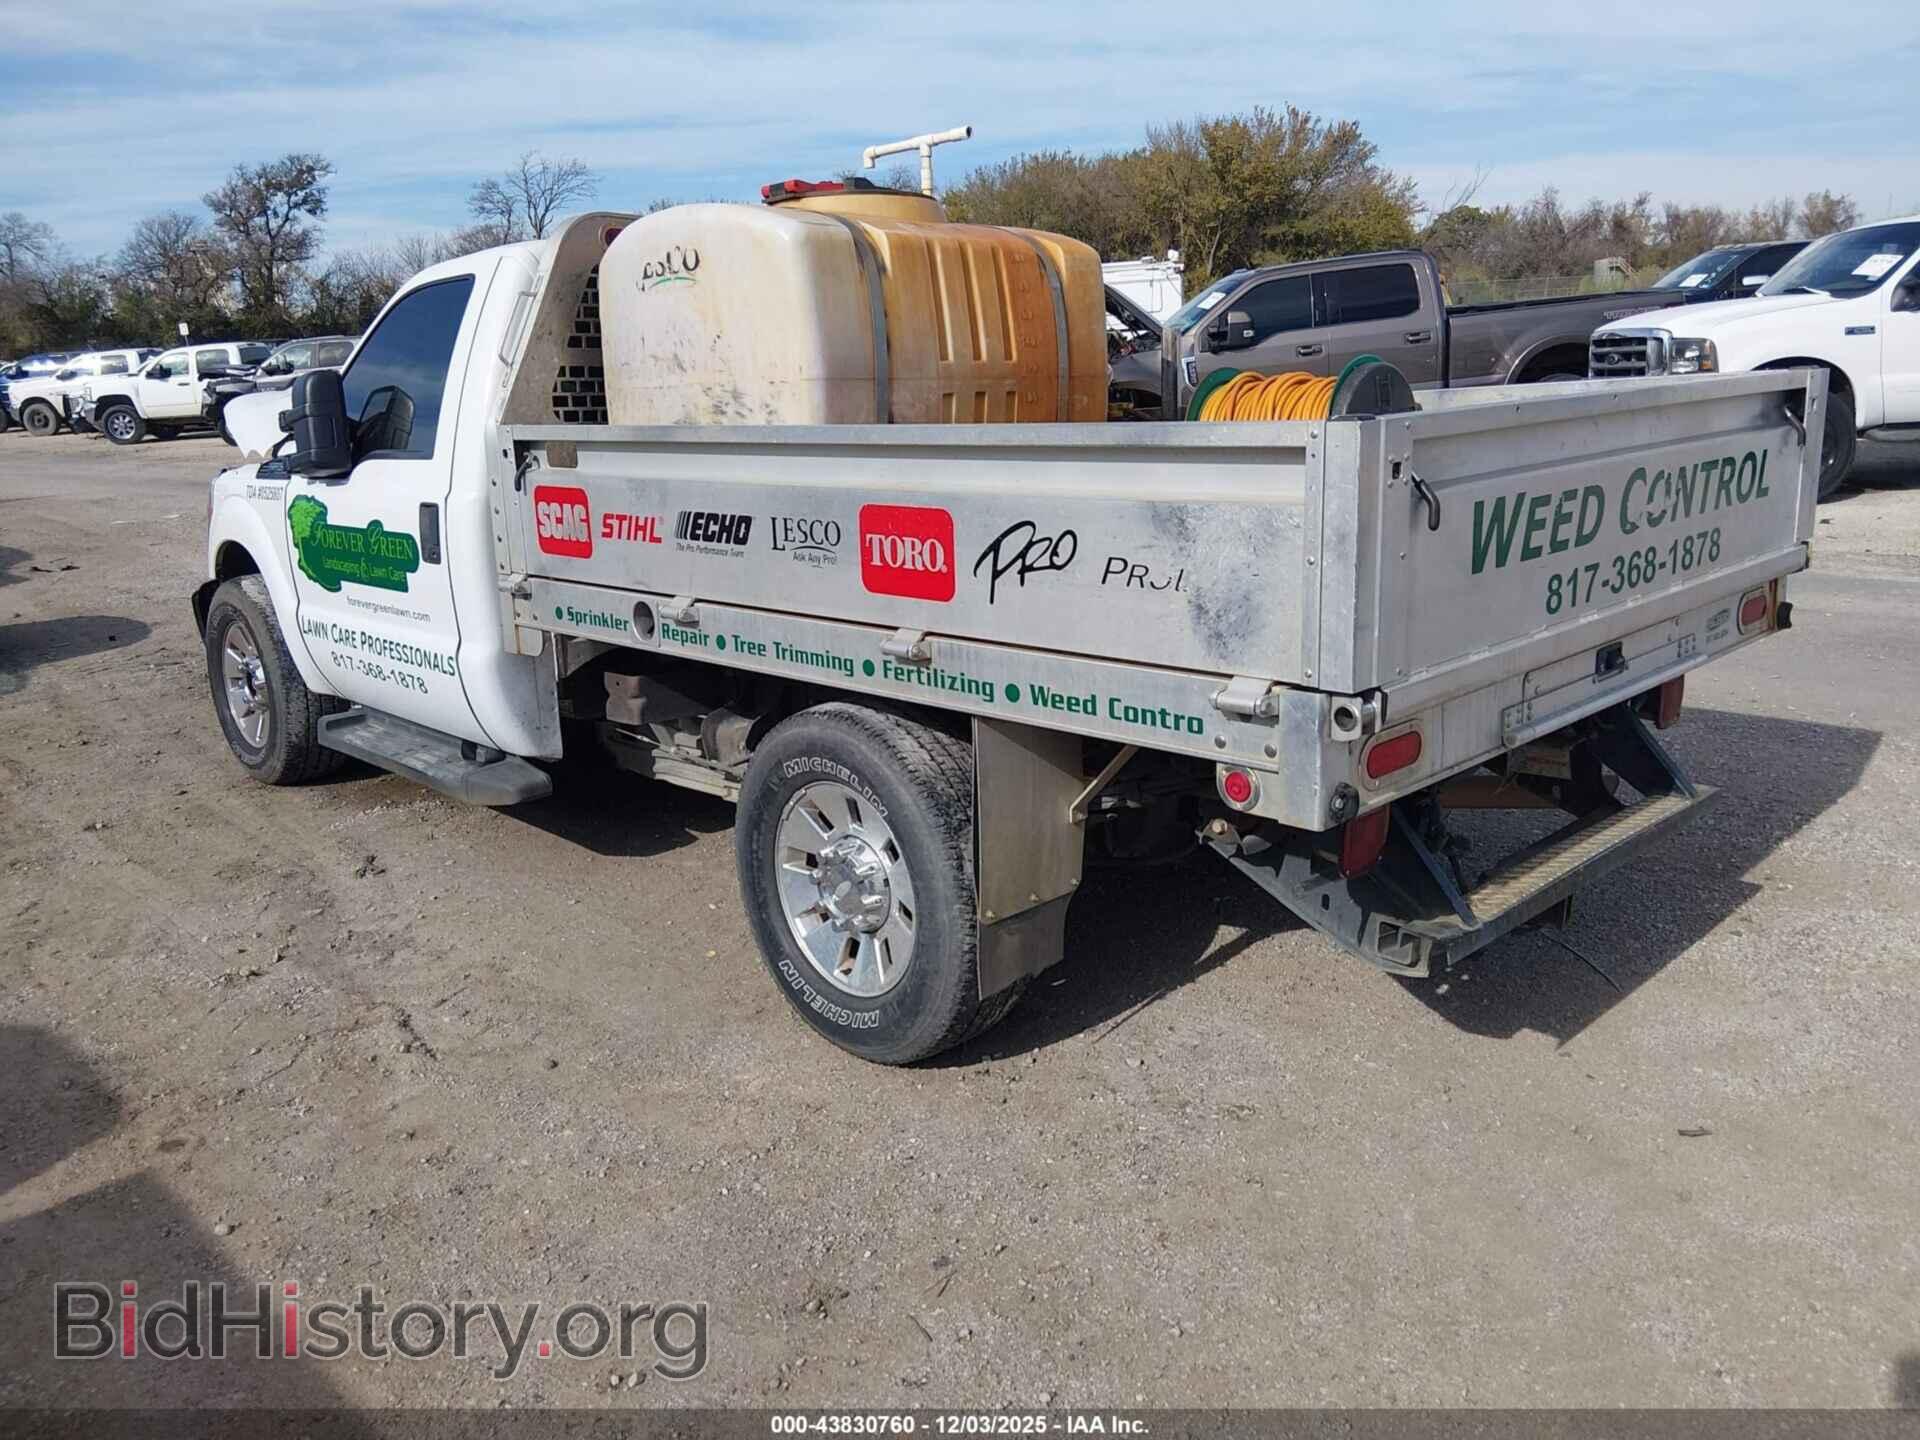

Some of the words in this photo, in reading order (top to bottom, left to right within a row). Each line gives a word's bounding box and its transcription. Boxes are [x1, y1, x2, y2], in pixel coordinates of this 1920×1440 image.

[536, 501, 590, 543] SCAG
[601, 512, 663, 544] STIHL
[688, 511, 753, 546] ECHO
[1471, 484, 1605, 575] WEED
[1619, 449, 1770, 535] CONTROL
[312, 521, 365, 554] FOREVER
[367, 526, 414, 561] GREEN
[770, 516, 841, 552] LESCO
[865, 533, 948, 573] TORO
[793, 551, 807, 561] Ask
[808, 552, 822, 564] Any
[1545, 527, 1722, 615] 817-368-1878
[302, 615, 328, 640] LAWN
[331, 623, 358, 649] CARE
[360, 631, 456, 676] PROFESSIONALS
[331, 650, 429, 694] 817-368-1878
[567, 606, 630, 632] Sprinkler
[661, 623, 710, 648] Repair
[731, 634, 767, 657] Tree
[772, 641, 855, 677] Trimming
[882, 659, 995, 703] Fertilizing
[1029, 683, 1098, 716] Weed
[1108, 697, 1205, 736] Contro
[783, 756, 889, 818] MICHELIN
[777, 958, 880, 1029] MICHELIN
